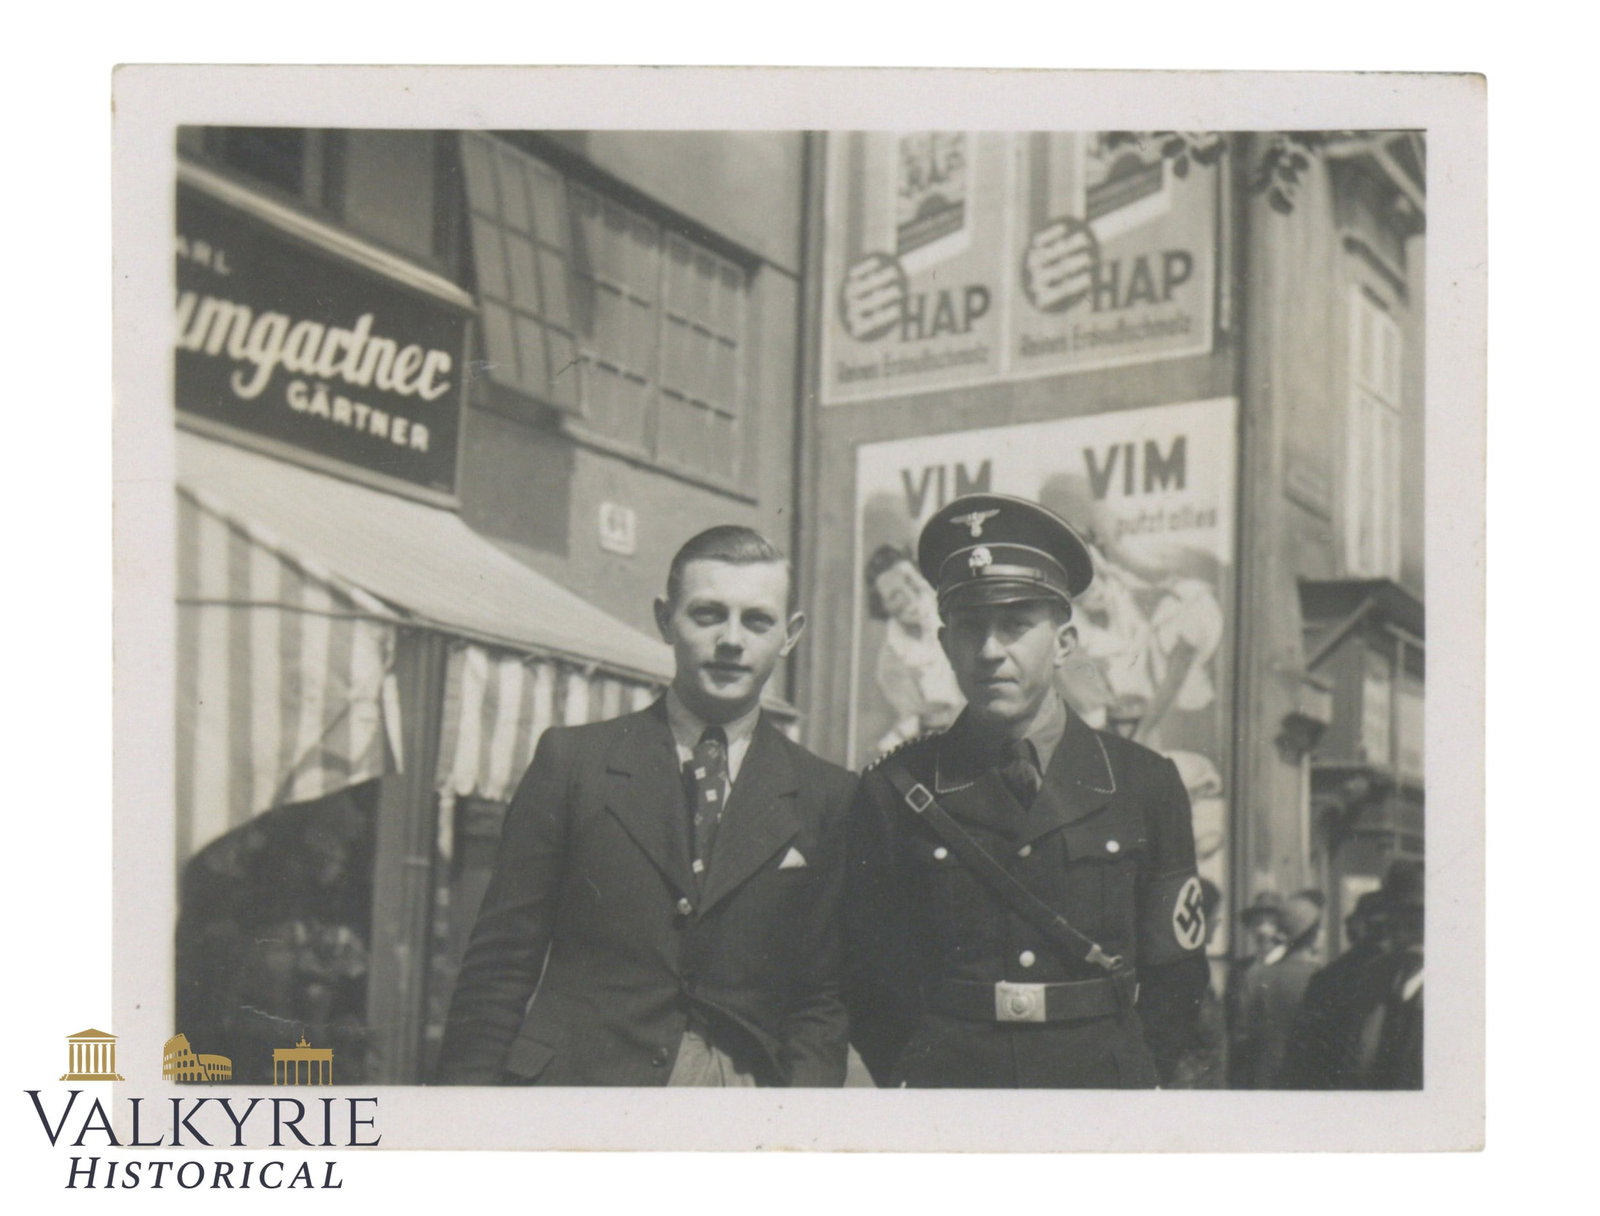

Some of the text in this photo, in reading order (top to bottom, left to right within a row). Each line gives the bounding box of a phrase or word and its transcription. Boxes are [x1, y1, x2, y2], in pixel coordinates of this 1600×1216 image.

[286, 380, 430, 453] GÄRTNER
[902, 460, 993, 519] VIM
[1083, 435, 1187, 501] VIM
